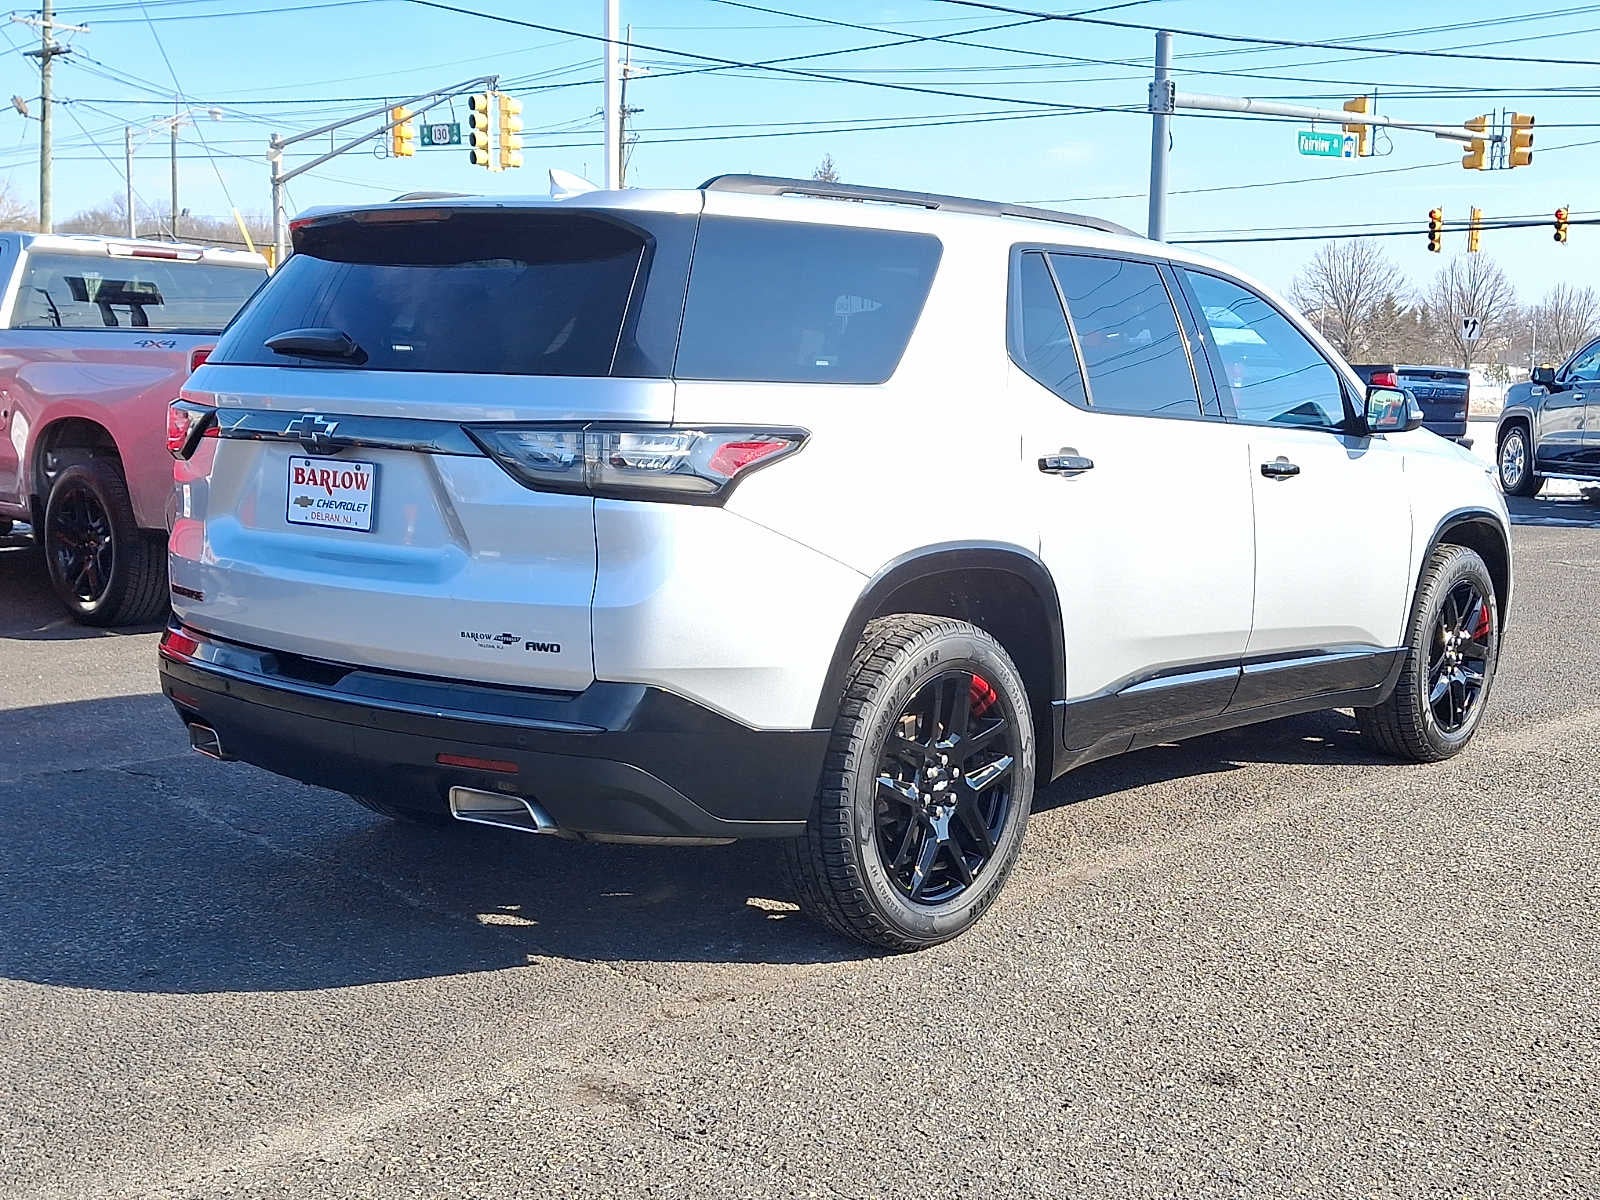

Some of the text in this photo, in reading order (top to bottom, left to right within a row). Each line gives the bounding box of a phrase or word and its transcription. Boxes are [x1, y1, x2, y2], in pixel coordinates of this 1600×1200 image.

[434, 128, 447, 141] 130
[1300, 135, 1330, 152] Fairview
[293, 467, 370, 497] BARLOW
[316, 499, 368, 513] CHEVROLET
[343, 515, 352, 524] NJ
[460, 631, 492, 642] BARLOW
[525, 641, 561, 654] AWD
